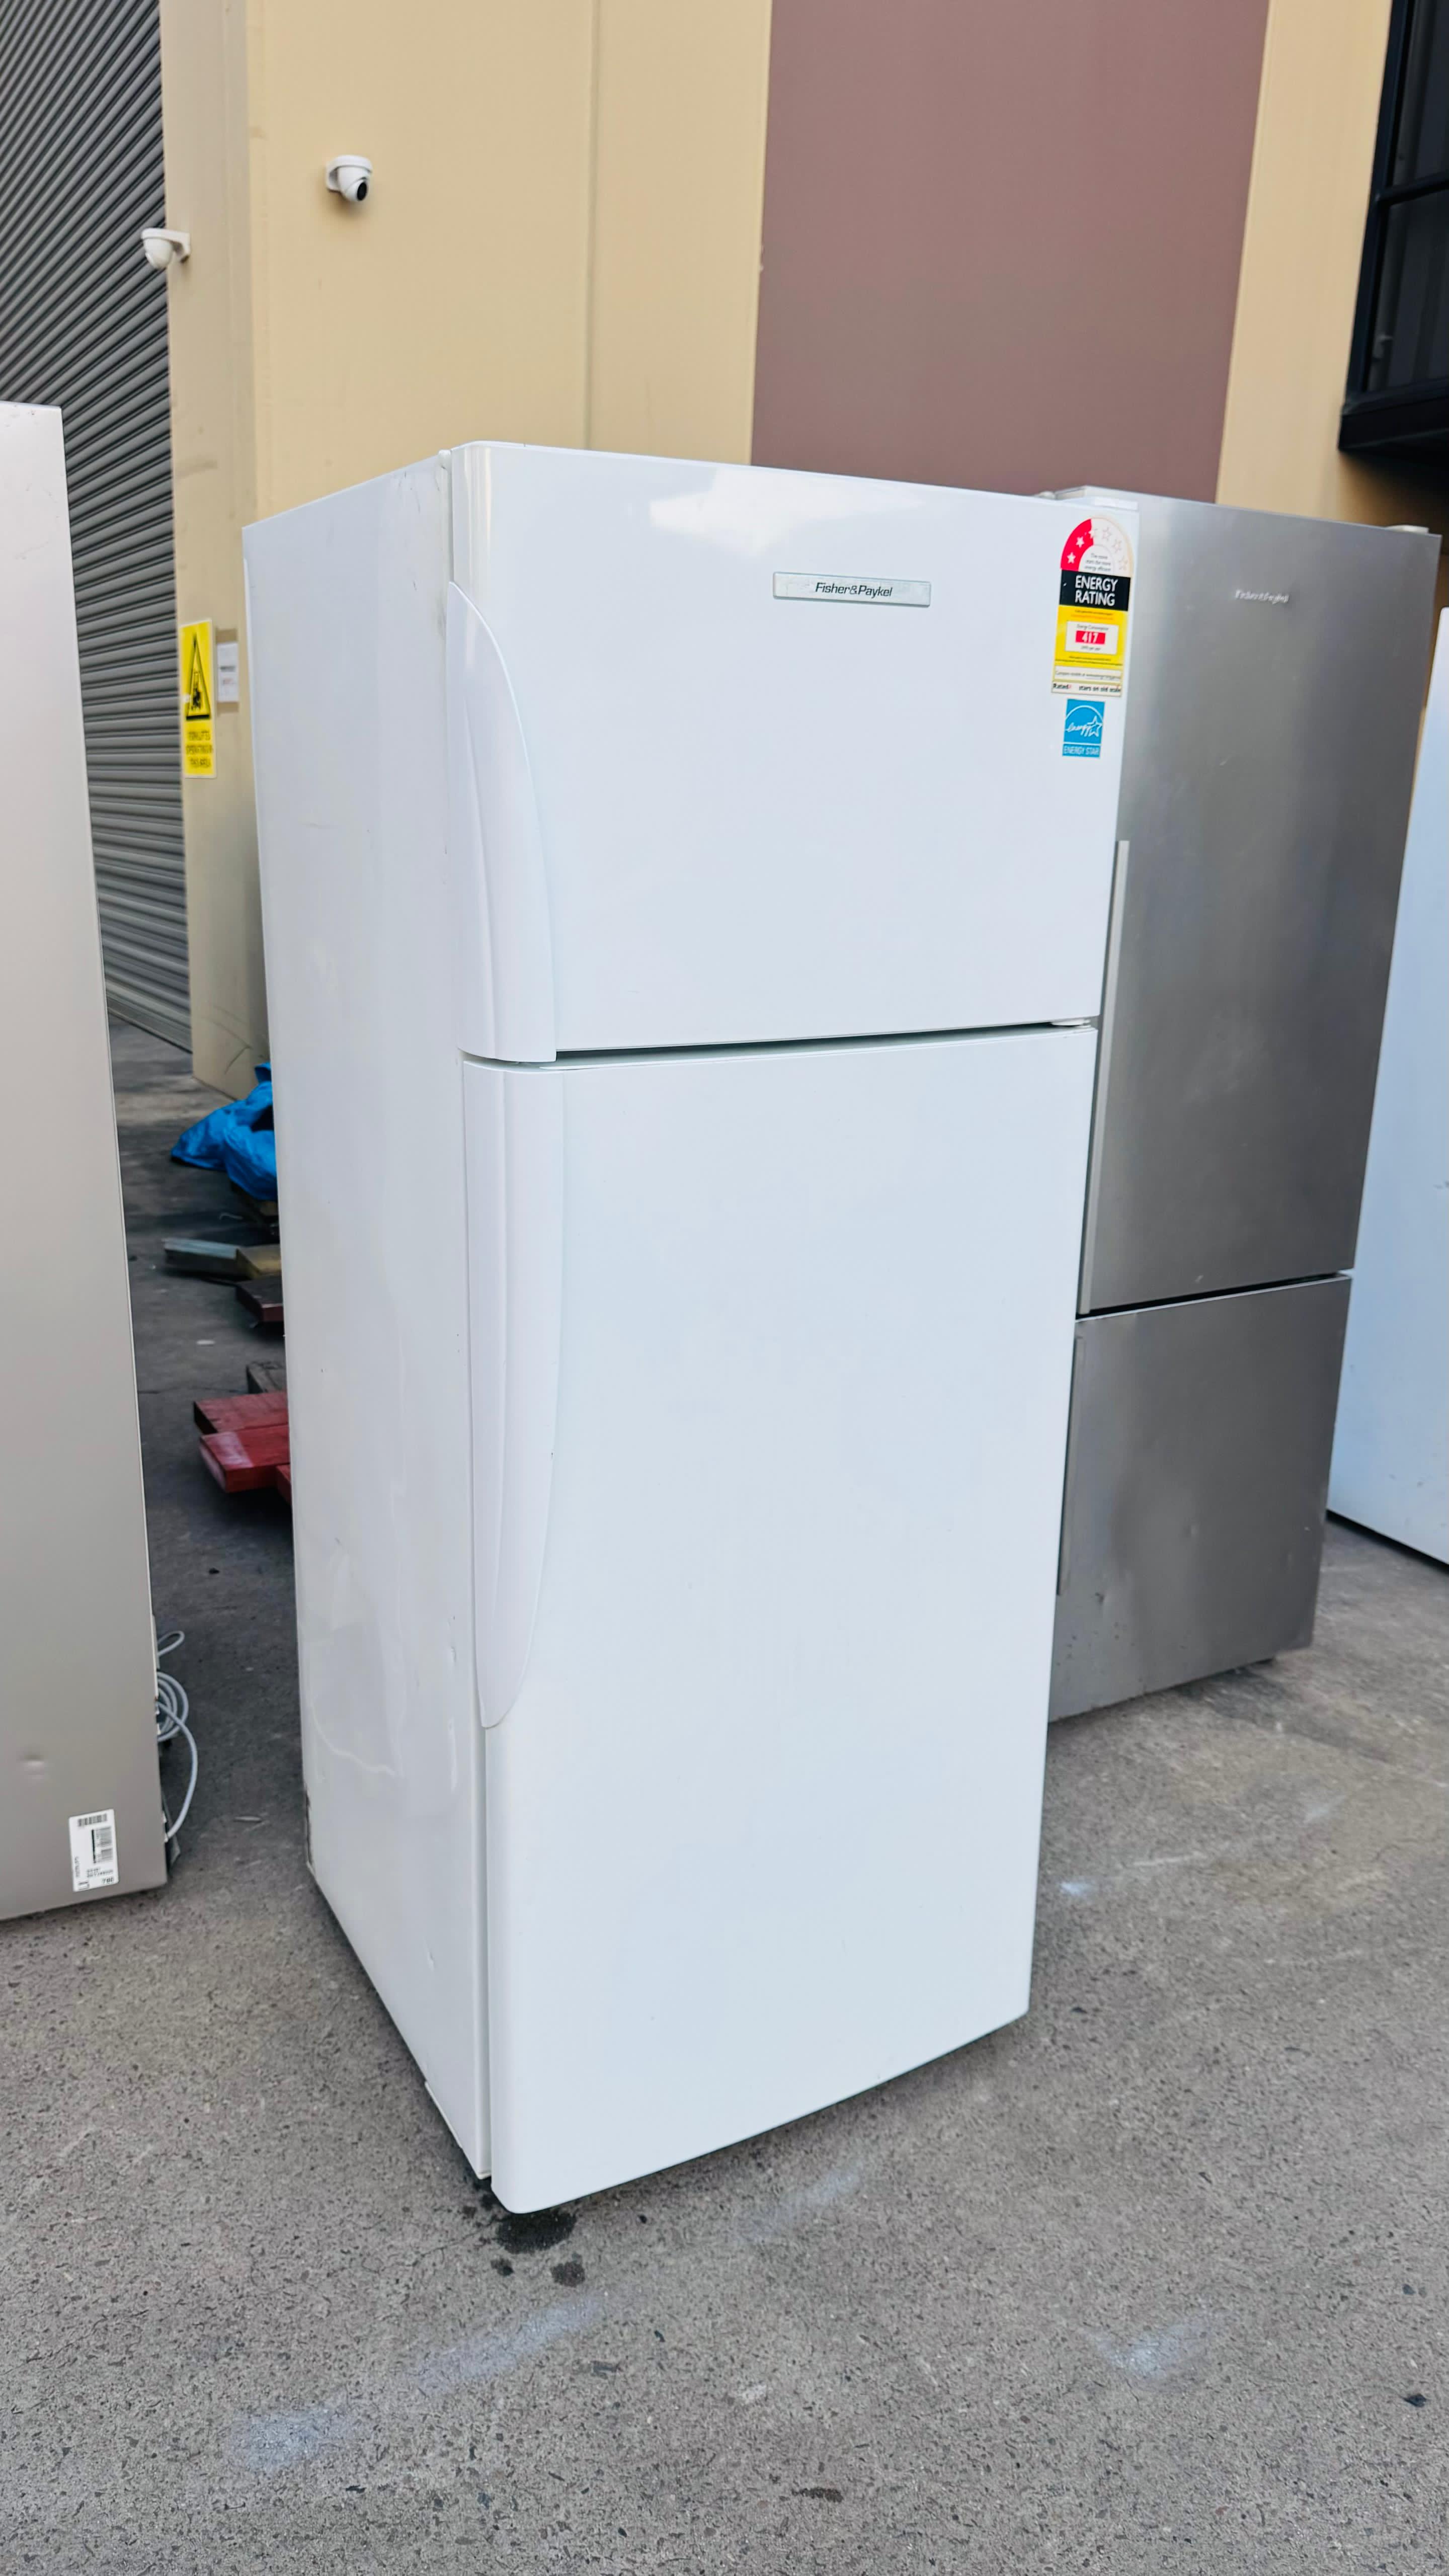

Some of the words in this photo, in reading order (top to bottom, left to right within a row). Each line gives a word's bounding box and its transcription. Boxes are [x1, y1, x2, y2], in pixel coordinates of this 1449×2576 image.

[815, 582, 893, 599] Fisher&Paykel
[1075, 576, 1118, 592] ENERGY
[1075, 590, 1115, 606] RATING
[1082, 632, 1099, 643] 417
